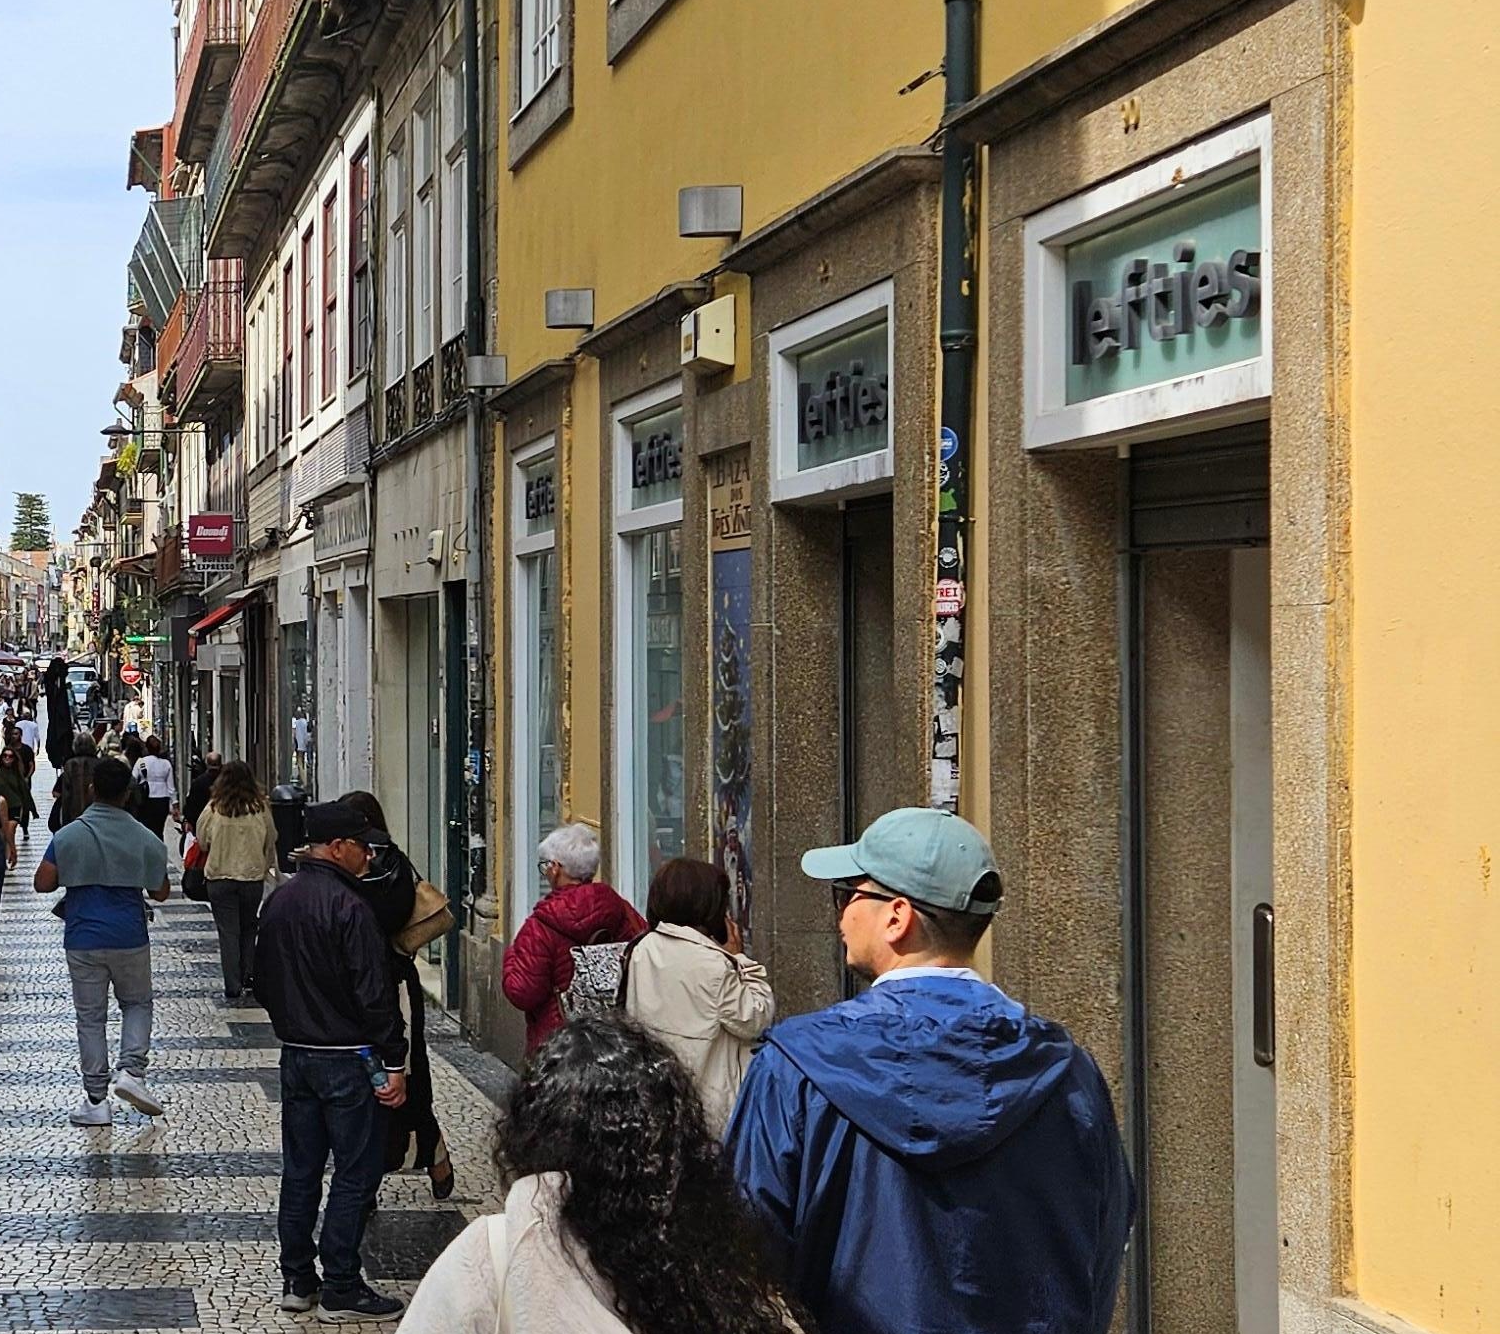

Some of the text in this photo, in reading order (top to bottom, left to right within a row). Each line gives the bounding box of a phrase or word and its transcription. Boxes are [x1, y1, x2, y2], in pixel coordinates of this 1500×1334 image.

[1072, 239, 1262, 366] lefties
[632, 432, 683, 488] leftie
[712, 454, 751, 489] BAZA
